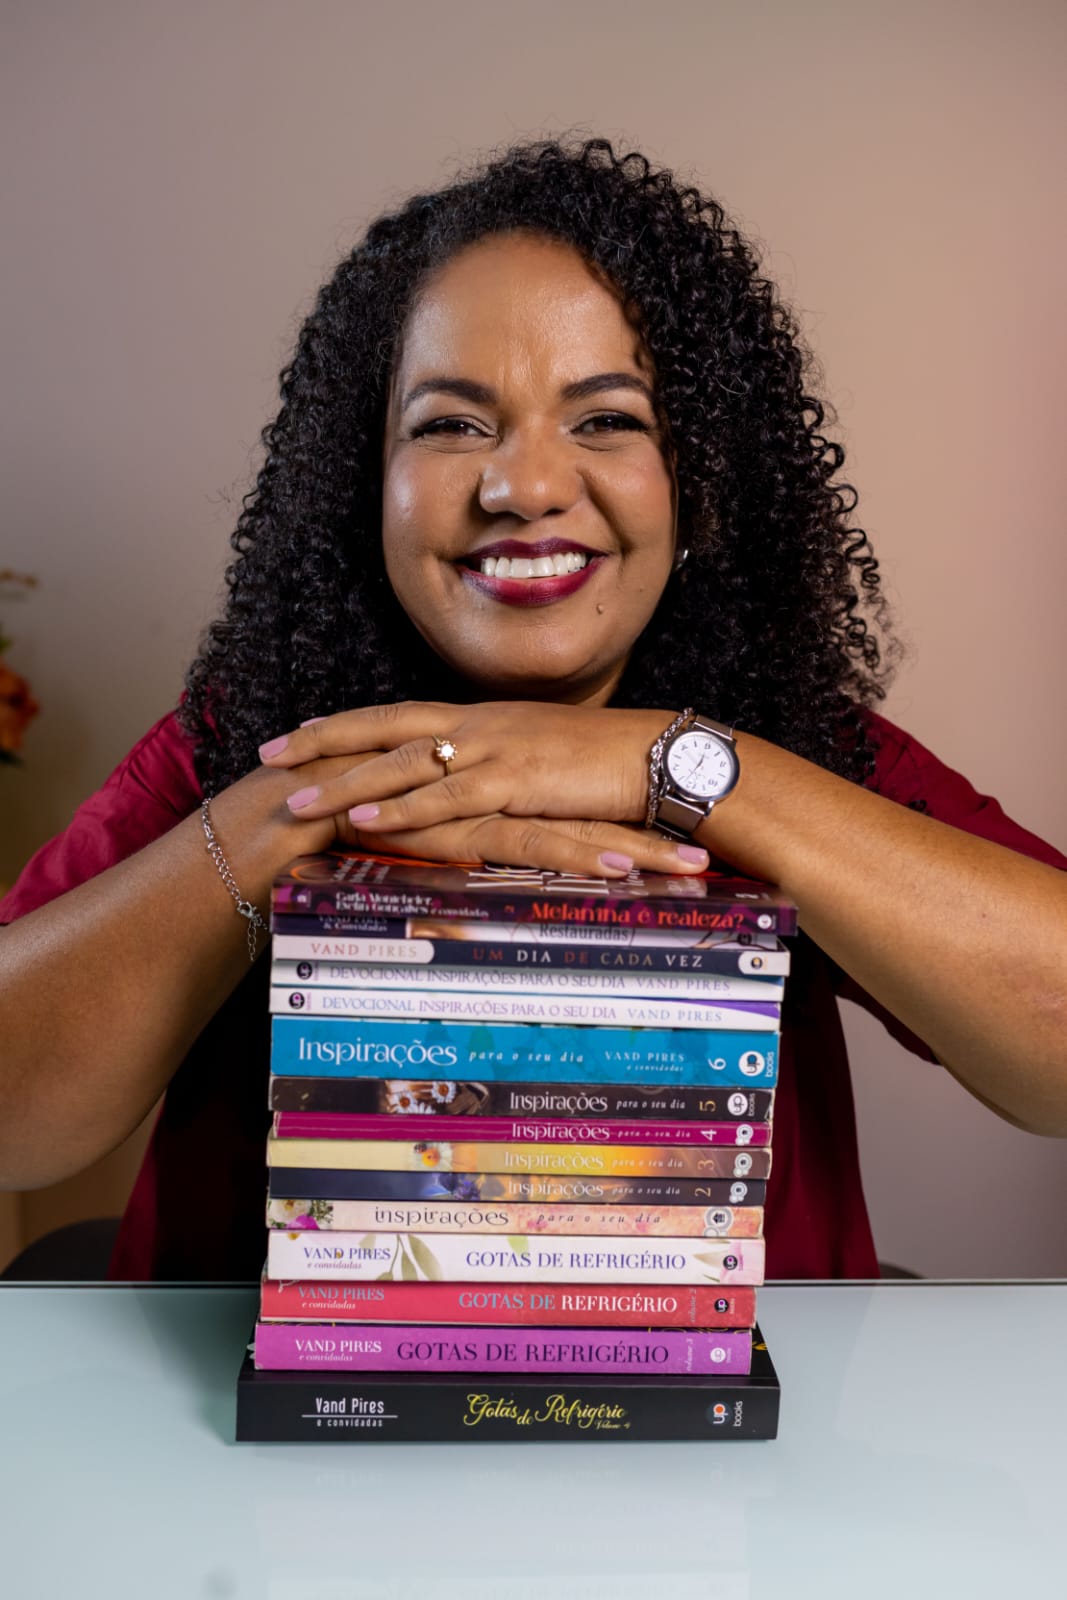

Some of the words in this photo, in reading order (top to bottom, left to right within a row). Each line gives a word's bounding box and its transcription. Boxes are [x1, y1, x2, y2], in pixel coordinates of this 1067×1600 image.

[532, 902, 630, 923] Melanina
[658, 907, 745, 929] realeza?
[538, 922, 629, 942] Restauradas
[311, 943, 359, 956] VAND
[368, 945, 417, 958] PIRES
[473, 948, 503, 961] UM
[517, 949, 552, 963] DIA
[564, 952, 589, 965] DE
[600, 952, 653, 966] CADA
[665, 954, 703, 968] VEZ
[330, 967, 423, 982] DEVOCIONAL
[426, 967, 517, 986] INSPIRAÇÕES
[522, 972, 555, 986] PARA
[558, 974, 569, 986] O
[571, 974, 599, 987] SEU
[601, 975, 625, 988] DIA
[636, 977, 679, 990] VAND
[686, 978, 731, 991] PIRES
[322, 996, 416, 1012] DEVOCIONAL
[419, 998, 509, 1016] INSPIRAÇÕES
[512, 1003, 548, 1017] PARA
[549, 1004, 560, 1017] O
[563, 1004, 590, 1018] SEU
[592, 1005, 616, 1019] DIA
[627, 1008, 671, 1021] VAND
[677, 1009, 722, 1022] PIRES
[299, 1037, 458, 1068] Inspirações
[468, 1050, 503, 1062] para
[512, 1052, 519, 1061] o
[528, 1052, 551, 1062] seu
[560, 1051, 584, 1063] dia
[604, 1050, 640, 1061] VAND
[647, 1051, 685, 1063] PIRES
[635, 1064, 684, 1073] convidadas
[707, 1058, 726, 1070] 6
[746, 1054, 761, 1073] up
[764, 1050, 774, 1078] books
[510, 1090, 608, 1114] Inspirações
[616, 1099, 639, 1110] para
[651, 1100, 668, 1109] seu
[670, 1098, 686, 1109] dia
[699, 1100, 716, 1112] 5
[747, 1093, 755, 1117] books
[512, 1122, 610, 1141] Inspirações
[617, 1129, 641, 1139] para
[644, 1130, 651, 1138] o
[654, 1129, 671, 1138] seu
[675, 1128, 691, 1138] dia
[700, 1129, 717, 1141] 4
[504, 1151, 604, 1170] Inspirações
[612, 1158, 635, 1168] para
[638, 1159, 645, 1167] o
[648, 1159, 664, 1167] seu
[667, 1156, 683, 1168] dia
[697, 1159, 715, 1171] 3
[508, 1180, 604, 1198] Inspirações
[611, 1186, 634, 1196] para
[646, 1187, 662, 1195] seu
[665, 1185, 681, 1195] dia
[694, 1186, 711, 1198] 2
[374, 1206, 510, 1229] inspirações
[536, 1212, 574, 1225] para
[584, 1214, 591, 1223] o
[600, 1214, 625, 1224] seu
[635, 1212, 662, 1224] dia
[304, 1247, 344, 1259] VAND
[349, 1248, 391, 1261] PIRES
[466, 1251, 531, 1268] GOTAS
[538, 1252, 563, 1268] DE
[570, 1250, 686, 1270] REFRIGÉRIO
[314, 1261, 363, 1270] convidadas
[298, 1286, 339, 1299] VAND
[343, 1288, 385, 1301] PIRES
[458, 1292, 523, 1309] GOTAS
[530, 1293, 555, 1309] DE
[561, 1291, 677, 1312] REFRIGÉRIO
[309, 1300, 356, 1310] convidadas
[295, 1339, 336, 1351] VAND
[340, 1340, 382, 1353] PIRES
[397, 1342, 478, 1361] GOTAS
[486, 1344, 516, 1362] DE
[525, 1340, 669, 1364] REFRIGÉRIO
[306, 1353, 353, 1362] convidadas
[316, 1398, 346, 1413] Vand
[351, 1398, 385, 1413] Pires
[463, 1393, 518, 1426] Gotas
[516, 1408, 533, 1425] de
[535, 1394, 625, 1429] Refrigério
[713, 1403, 729, 1424] up
[733, 1401, 743, 1427] books
[316, 1418, 322, 1427] e
[327, 1417, 383, 1427] convidadas
